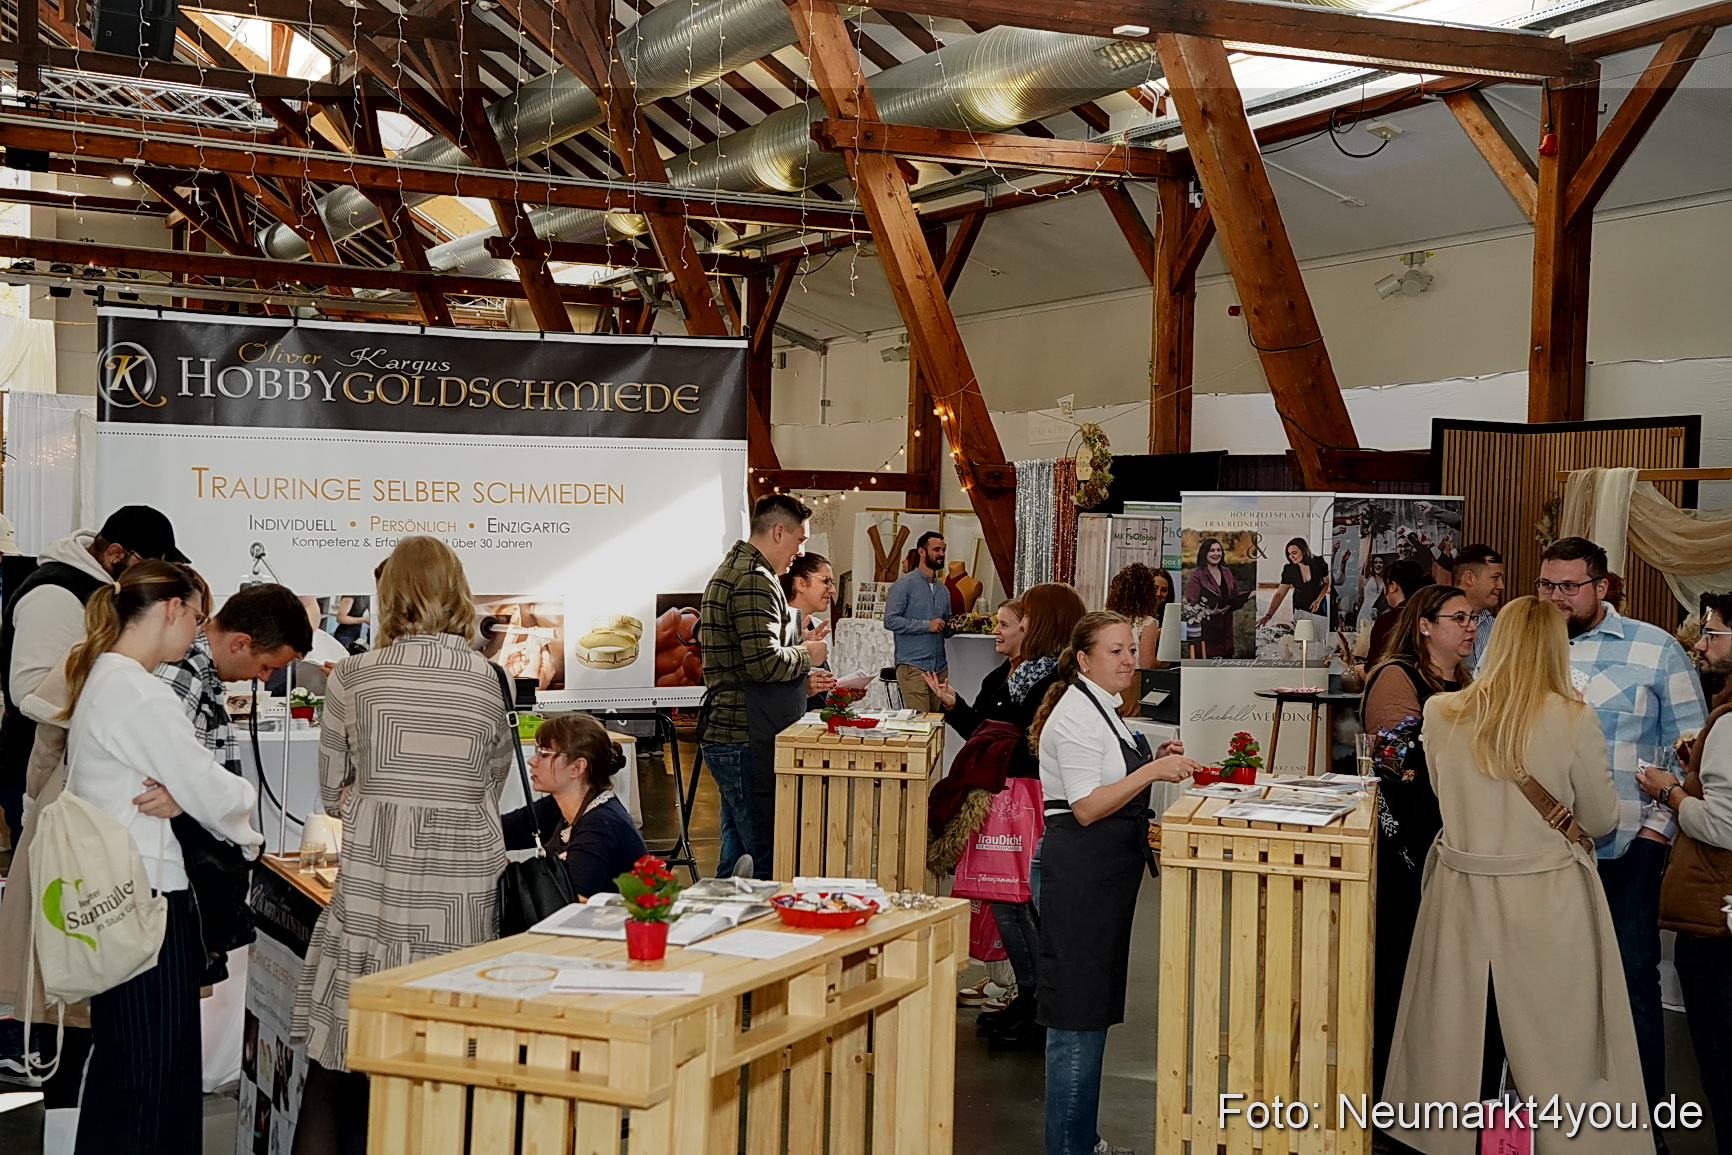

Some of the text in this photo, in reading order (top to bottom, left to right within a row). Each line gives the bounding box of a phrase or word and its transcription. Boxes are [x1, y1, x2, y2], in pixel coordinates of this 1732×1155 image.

[238, 341, 451, 375] Oliver Kargus
[177, 356, 701, 414] HOBBYGOLDSCHMIEDE
[191, 467, 625, 505] TRAURINGE SELBER SCHMIEDEN
[249, 514, 571, 534] INDIVIDUELL PERSÖNLICH EINZIGARTIG
[1230, 511, 1321, 519] HOCHZEITSPLANERIN
[292, 536, 360, 549] Kompetenz
[363, 537, 372, 547] &
[452, 538, 477, 549] über
[480, 538, 493, 549] 30
[496, 538, 533, 549] Jahren
[1246, 533, 1268, 560] &
[977, 833, 1023, 846] TrauDich!
